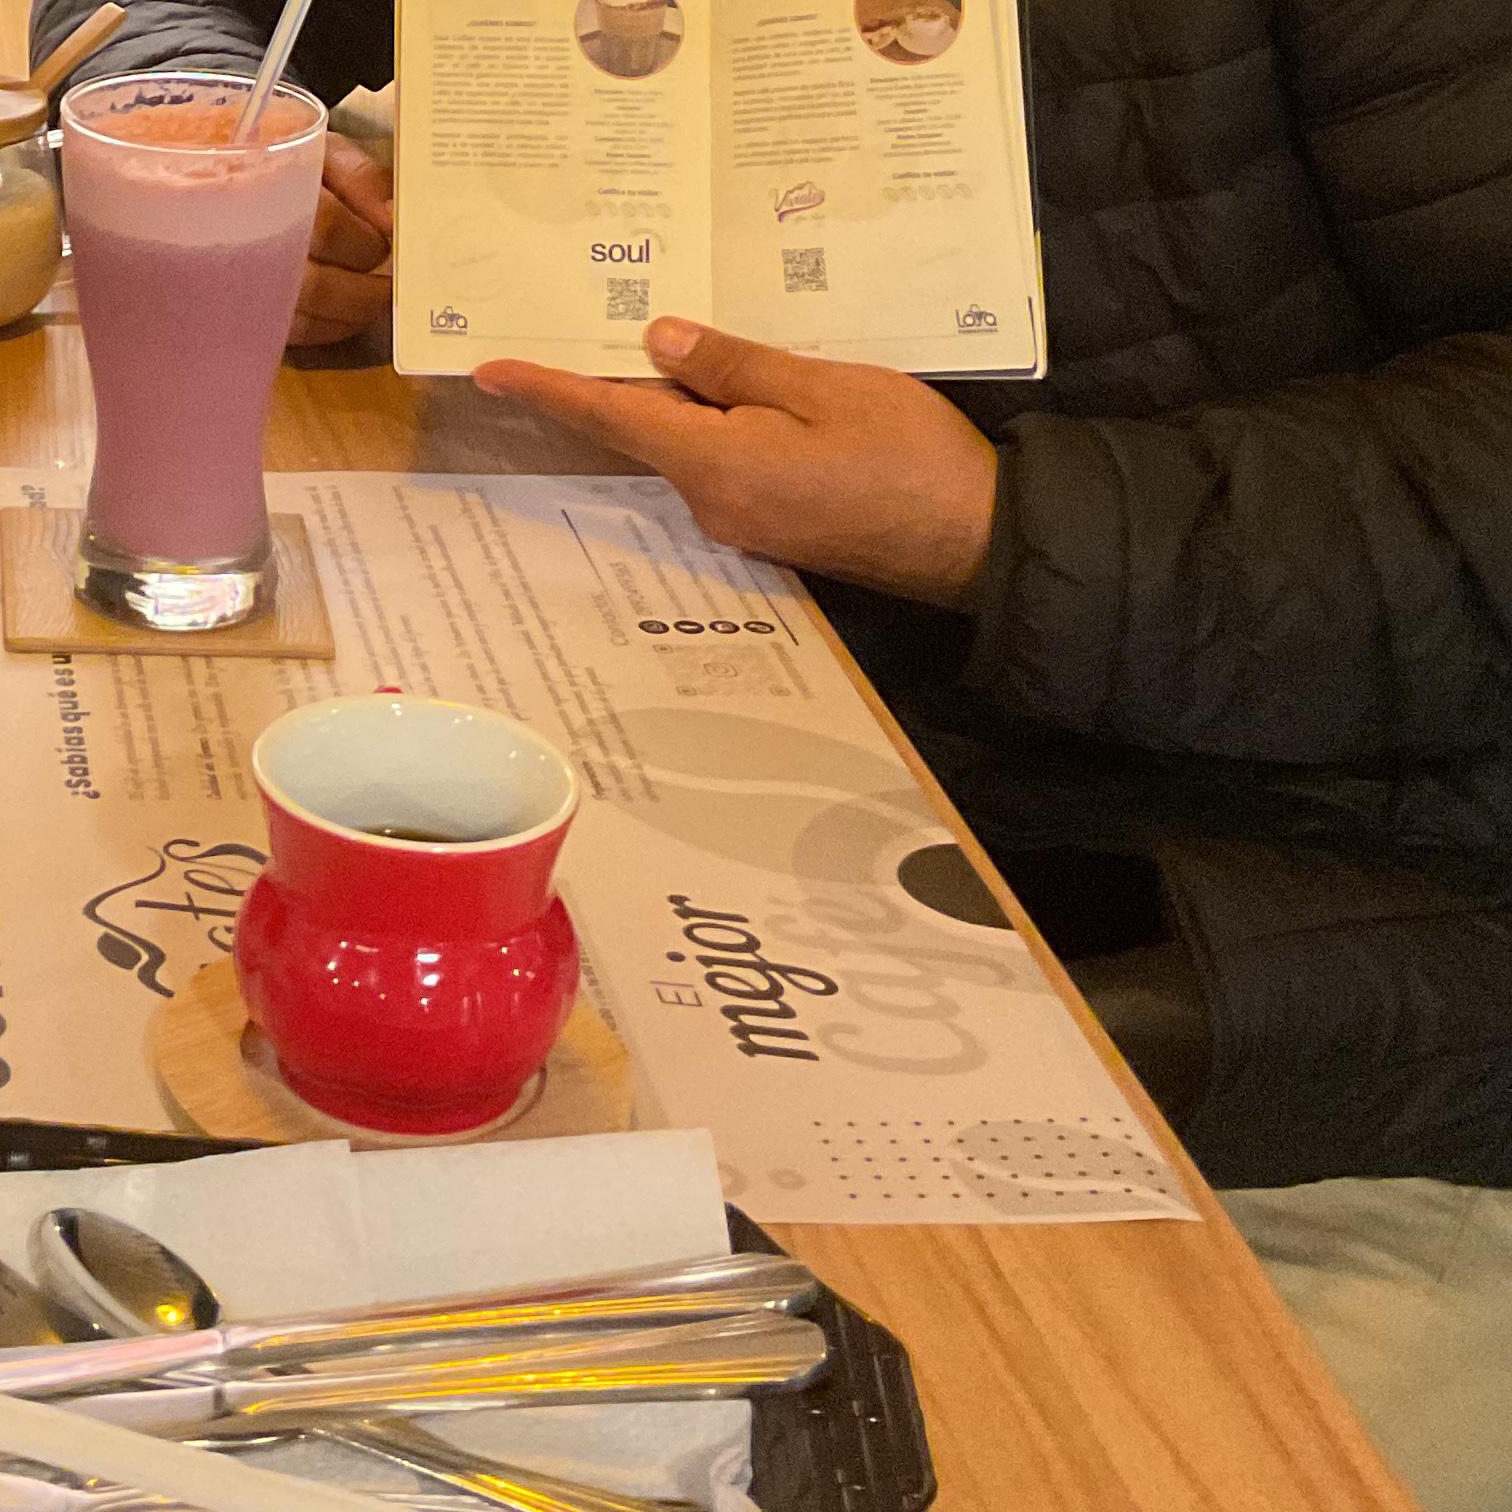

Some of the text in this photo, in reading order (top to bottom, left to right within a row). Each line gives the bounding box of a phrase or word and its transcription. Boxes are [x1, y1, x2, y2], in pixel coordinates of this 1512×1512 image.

[591, 238, 651, 264] soul
[53, 667, 76, 687] es
[47, 689, 91, 723] qué
[55, 725, 101, 800] ¿Sabías
[666, 893, 840, 1063] mejor
[657, 980, 703, 1009] El
